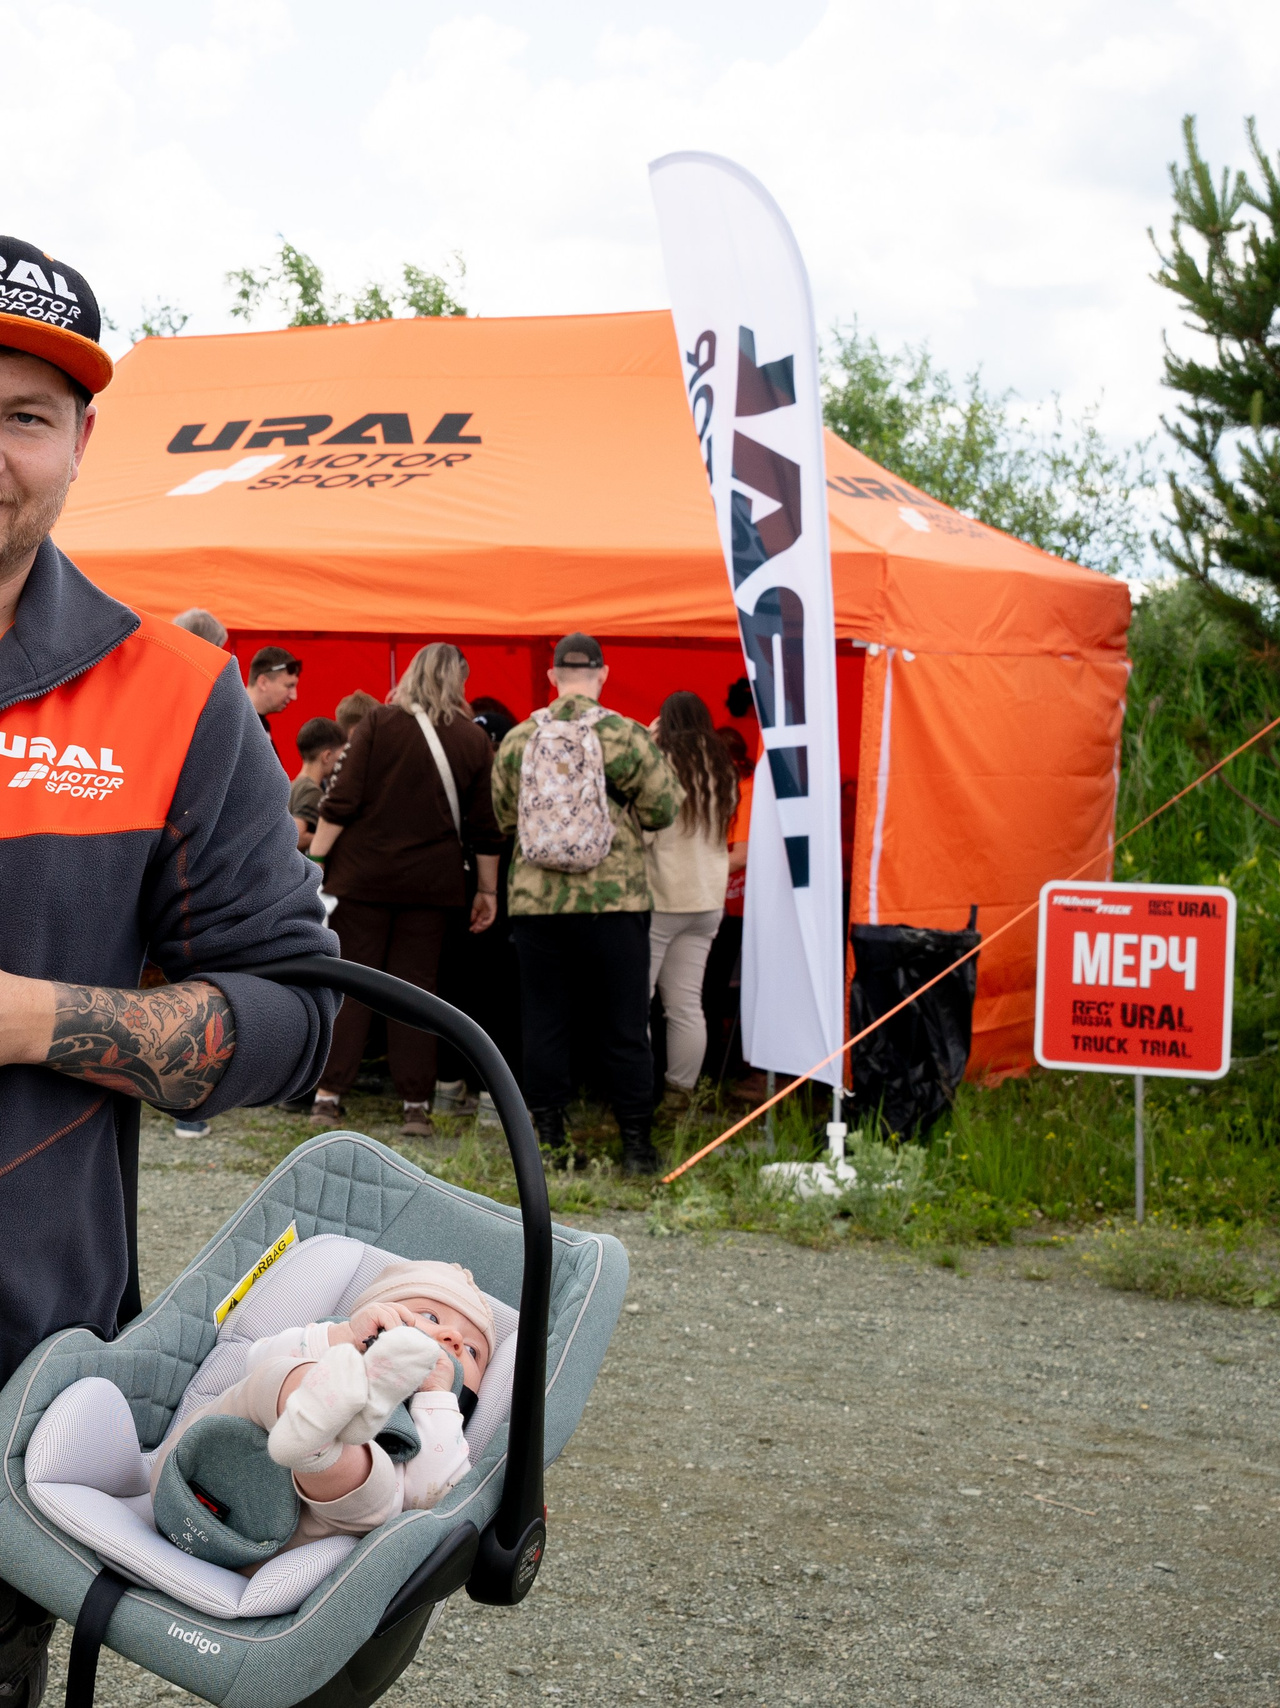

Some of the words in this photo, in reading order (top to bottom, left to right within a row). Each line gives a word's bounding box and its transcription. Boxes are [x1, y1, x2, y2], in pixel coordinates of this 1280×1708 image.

[166, 412, 483, 454] URAL
[278, 453, 472, 470] MOTOR
[247, 473, 433, 490] SPORT
[49, 770, 124, 789] MOTOR
[45, 781, 113, 801] SPORT
[1178, 901, 1222, 919] URAL
[1072, 931, 1197, 991] МЕРЧ
[1121, 1002, 1193, 1032] URAL
[1072, 1034, 1128, 1055] TRUCK
[1140, 1039, 1192, 1059] TRIAL
[182, 1532, 194, 1544] &
[183, 1517, 209, 1543] Safe
[167, 1621, 221, 1654] Indigo
